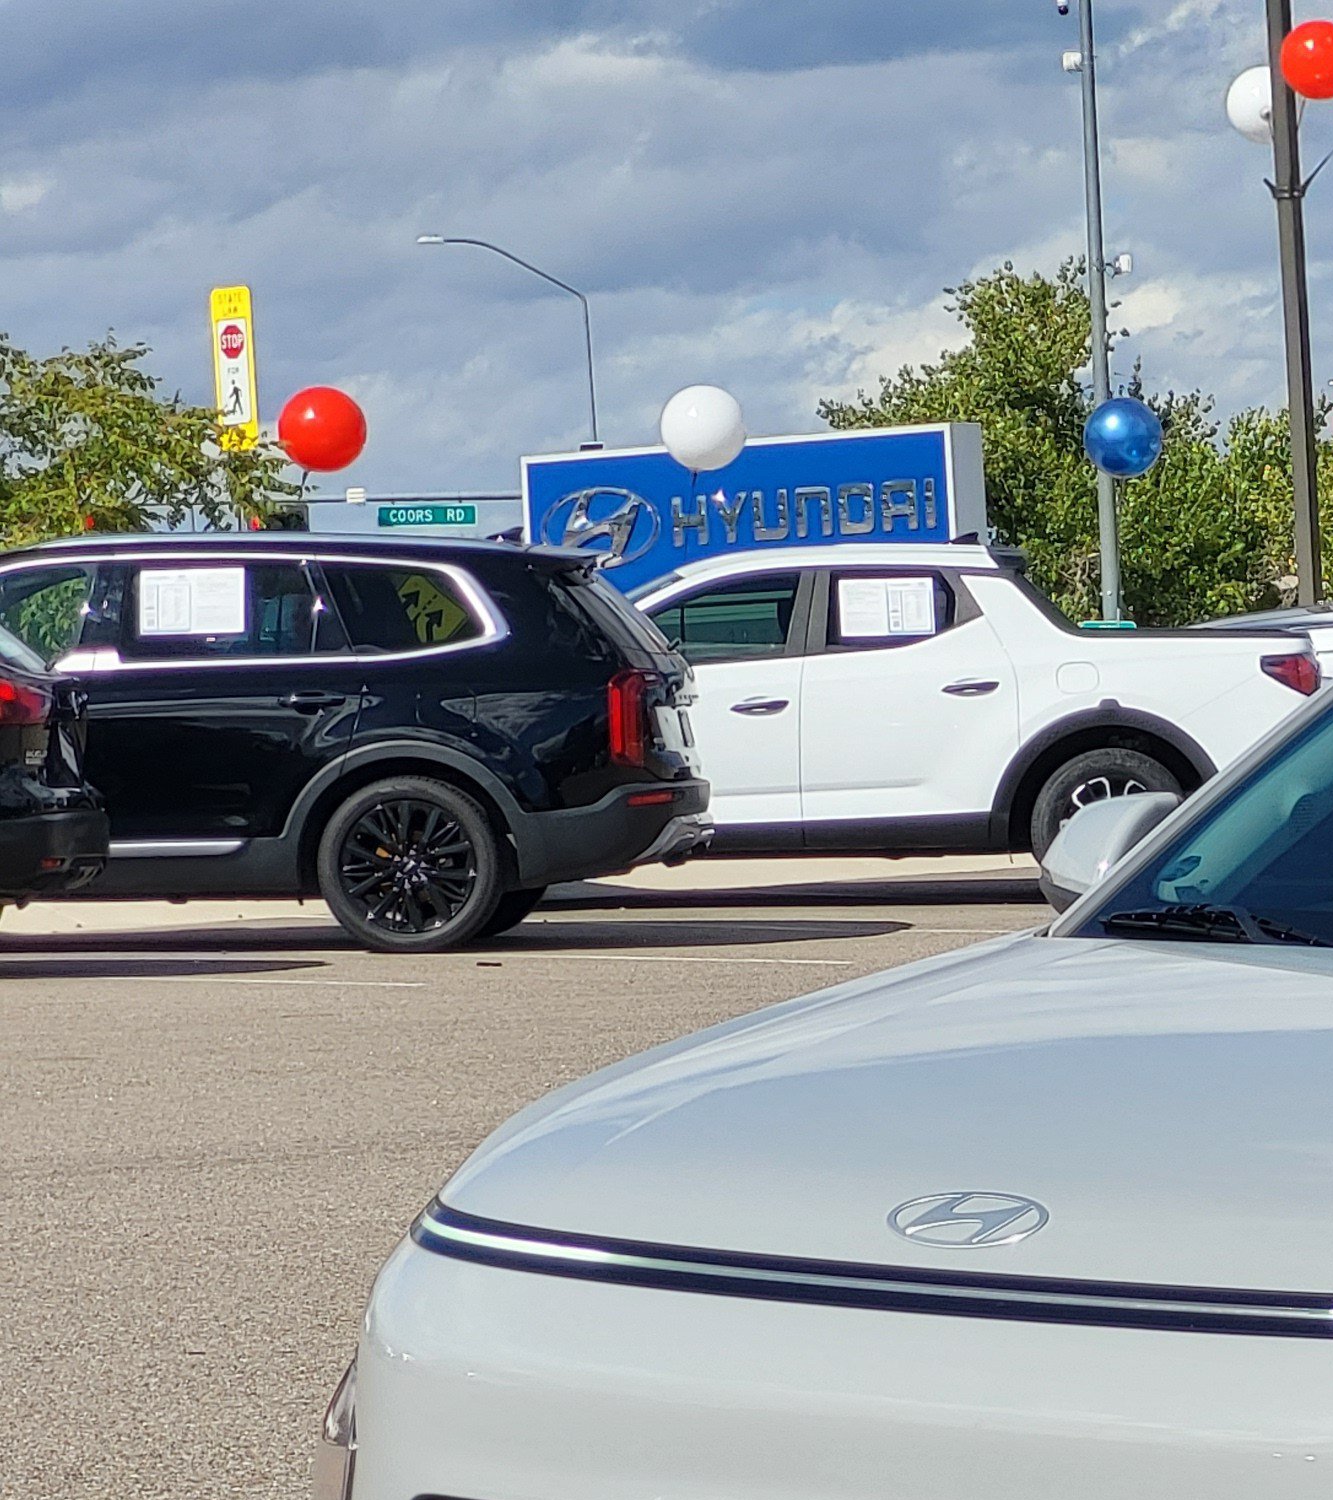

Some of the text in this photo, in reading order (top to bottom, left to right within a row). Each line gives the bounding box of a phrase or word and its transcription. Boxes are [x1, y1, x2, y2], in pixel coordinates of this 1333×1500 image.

[221, 333, 245, 350] STOP
[389, 508, 465, 523] COORS RD
[671, 477, 936, 547] HYUNDAI
